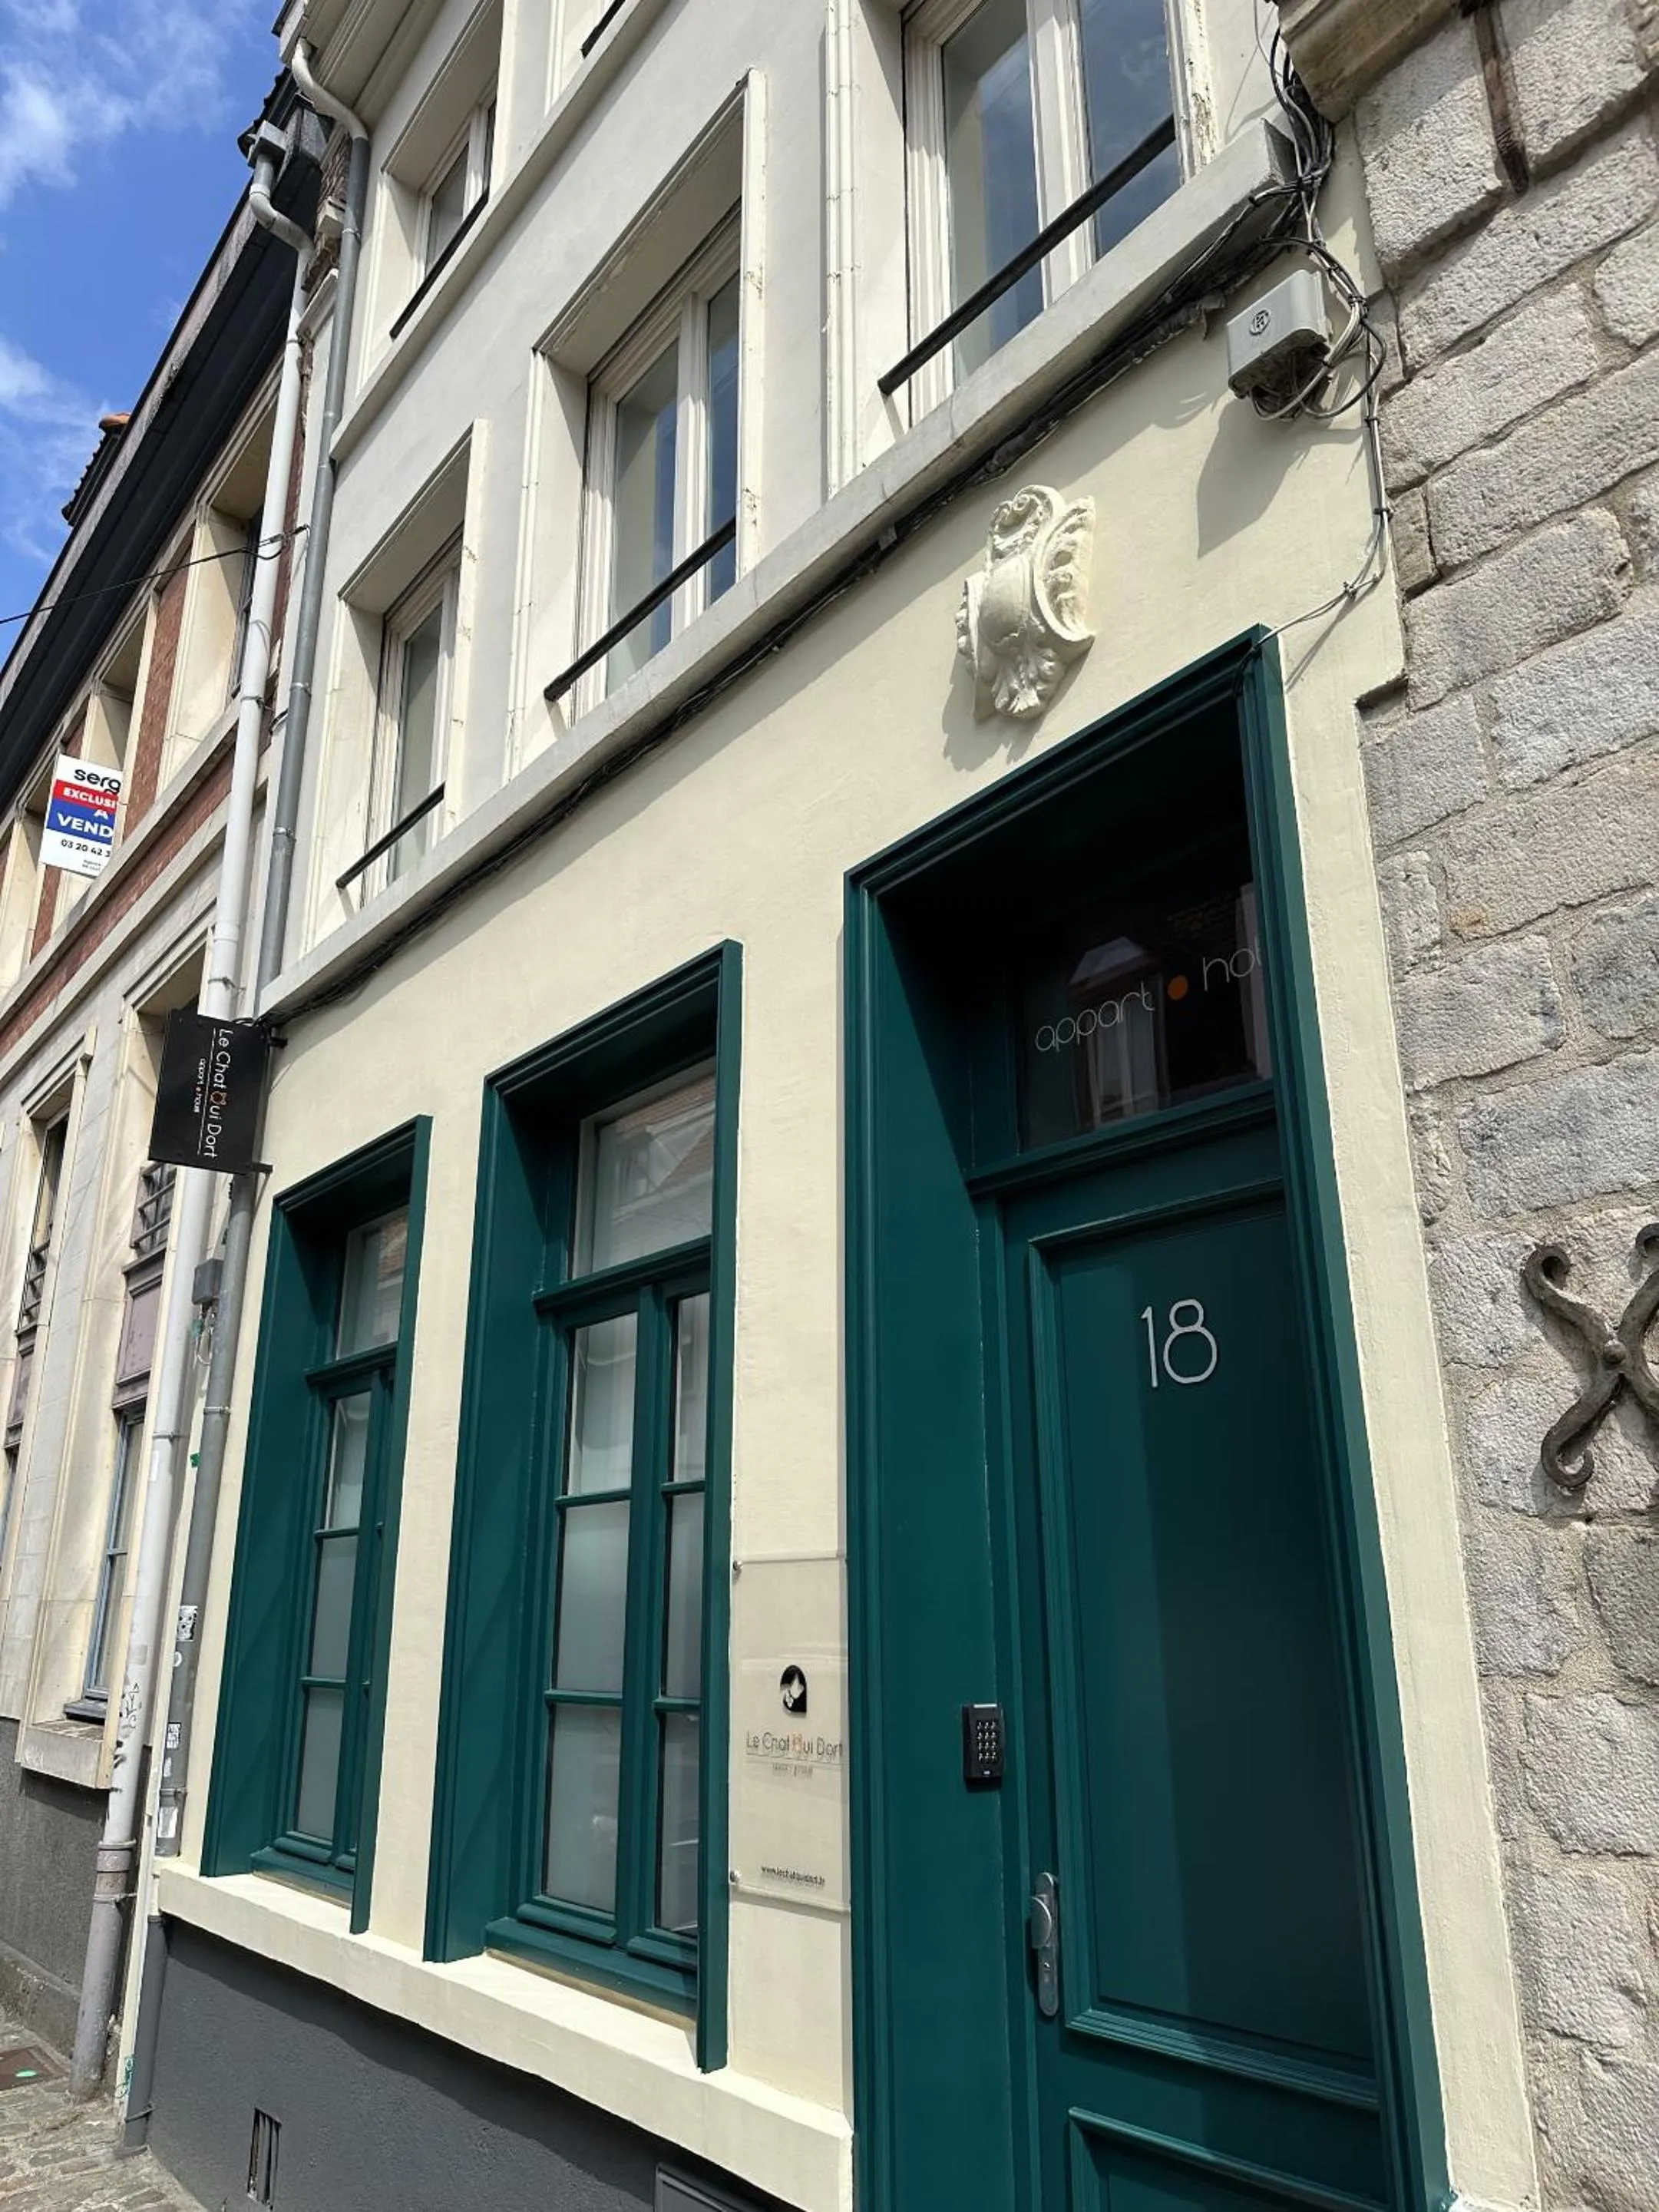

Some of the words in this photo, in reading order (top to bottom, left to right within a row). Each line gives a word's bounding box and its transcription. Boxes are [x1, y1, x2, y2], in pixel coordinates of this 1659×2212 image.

[74, 769, 121, 795] serg
[57, 812, 114, 838] VEND
[61, 839, 74, 849] 03
[75, 843, 88, 852] 20
[1035, 980, 1155, 1053] appart
[217, 1028, 234, 1048] Le
[213, 1050, 231, 1089] Chat
[203, 1123, 223, 1159] Dort
[1141, 1298, 1218, 1388] 18
[745, 1731, 760, 1749] Le
[762, 1731, 790, 1752] Chat
[816, 1736, 844, 1757] Dort
